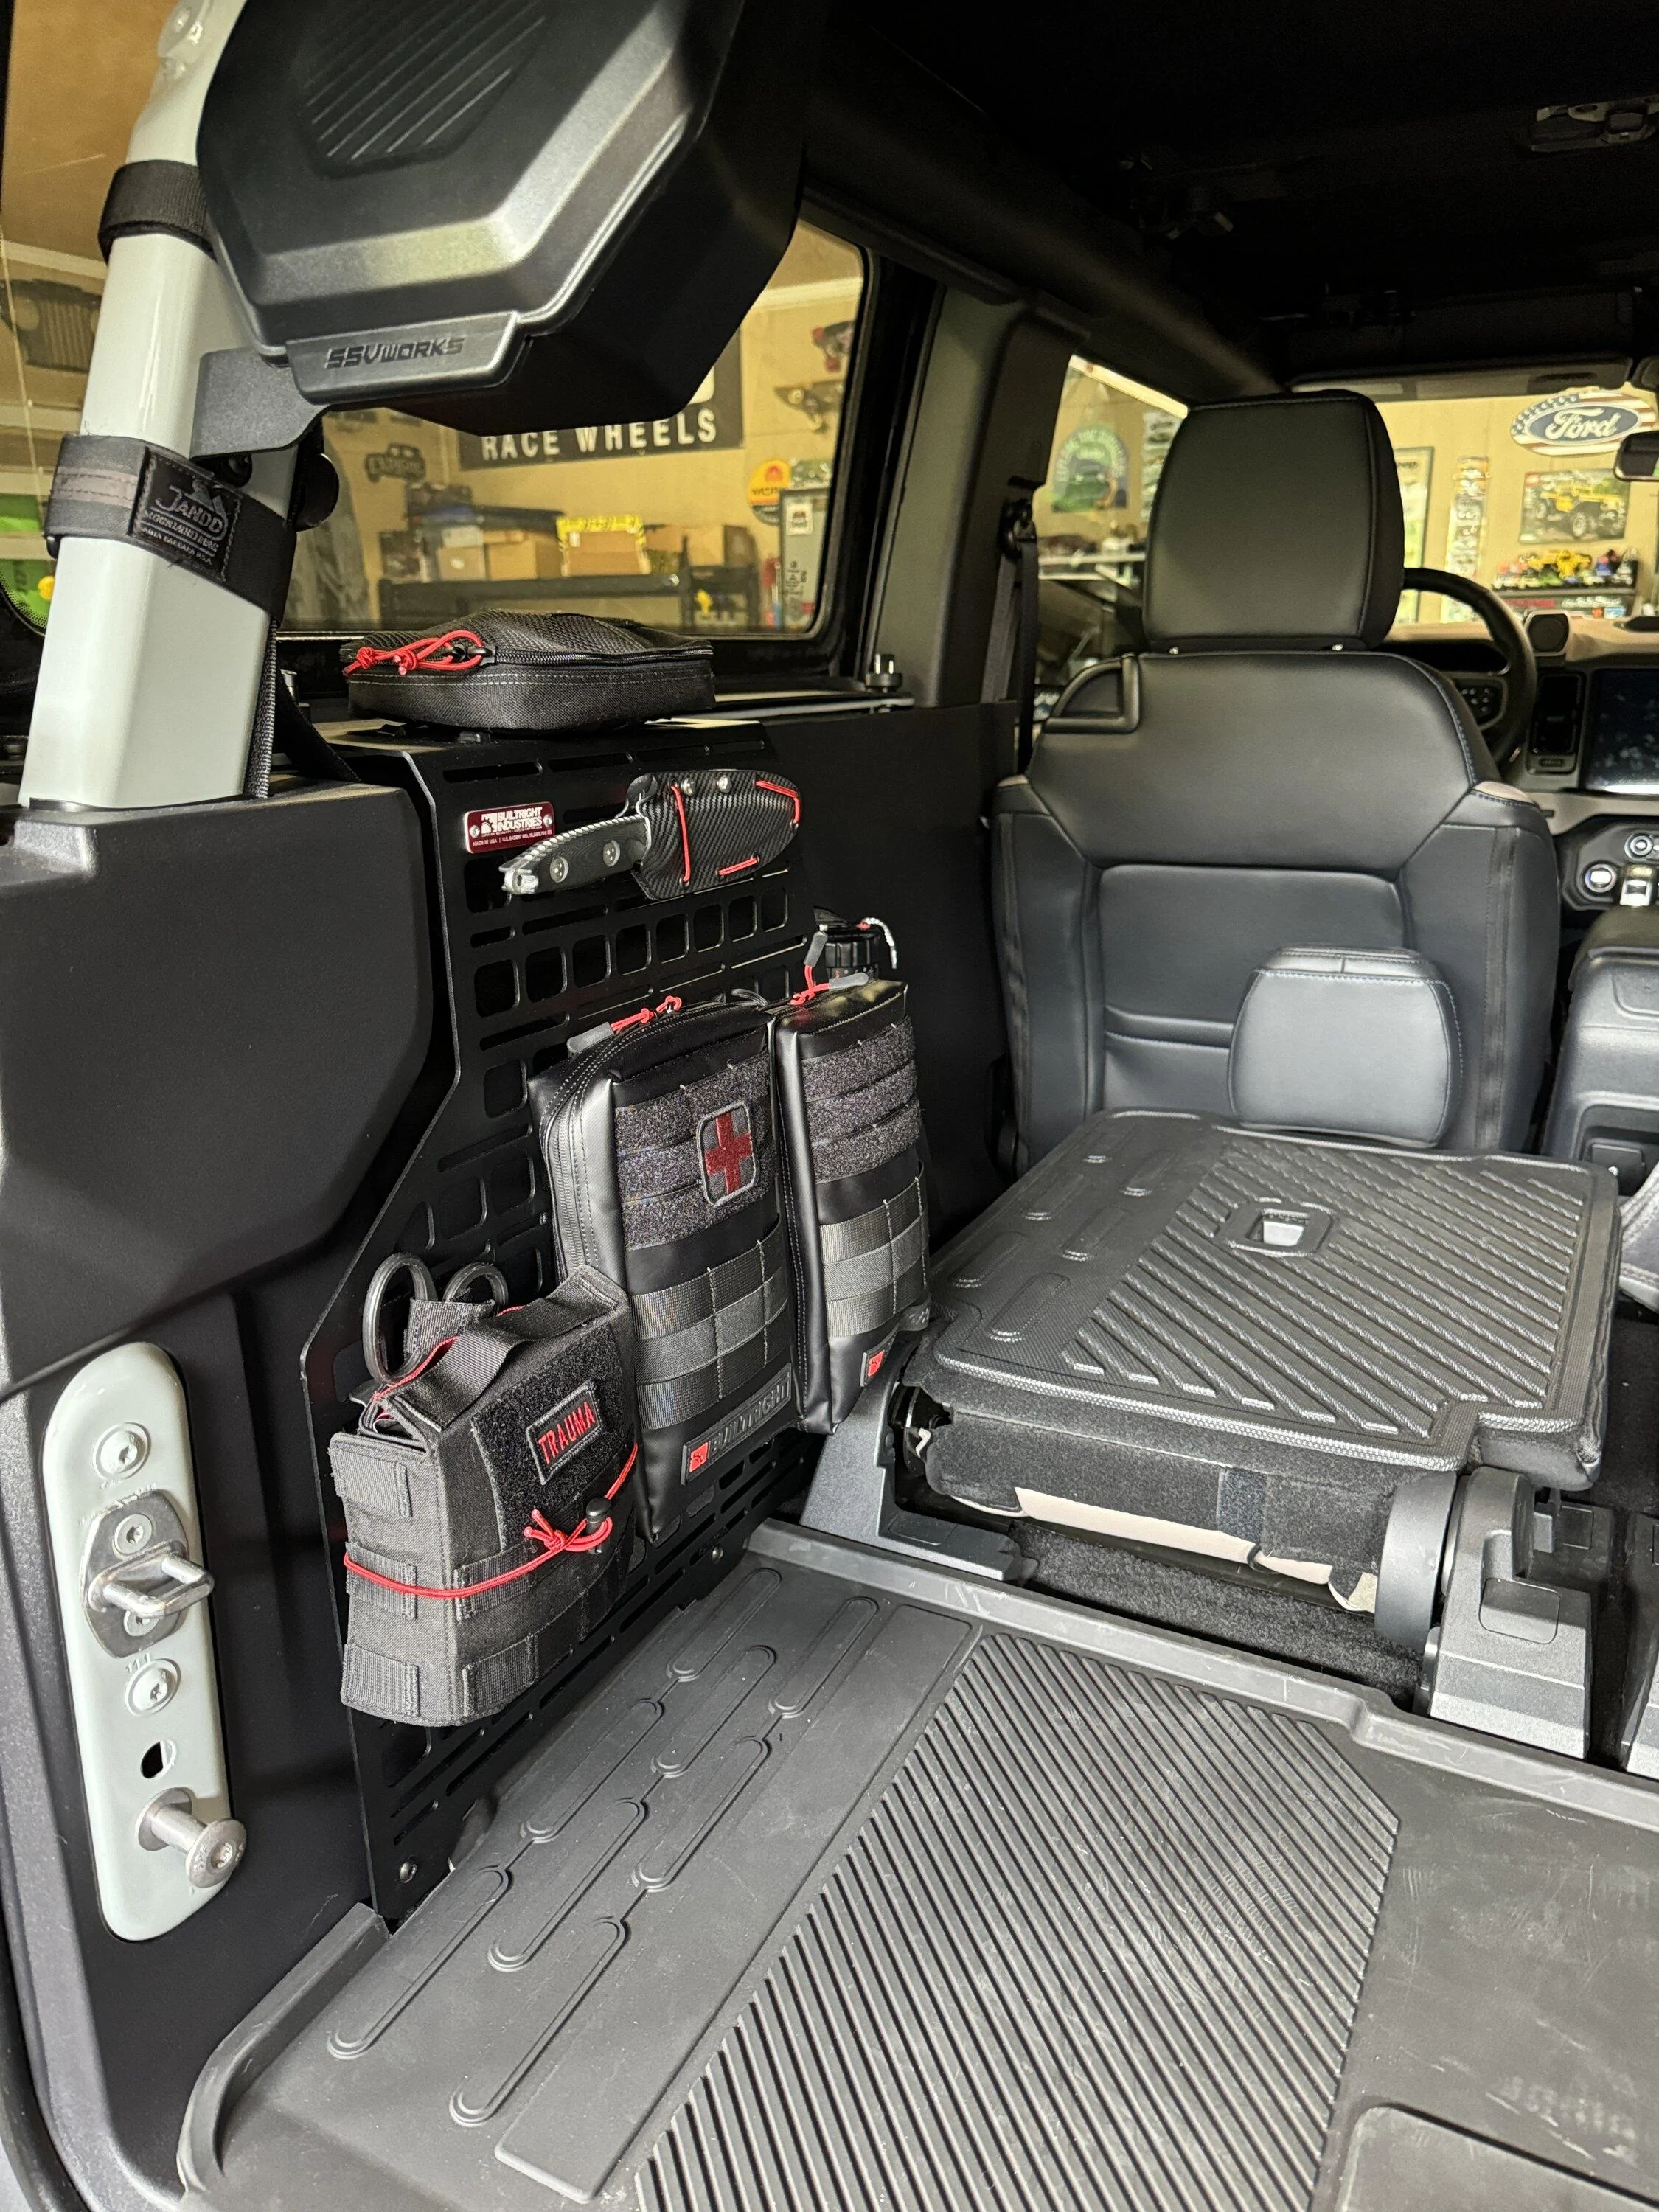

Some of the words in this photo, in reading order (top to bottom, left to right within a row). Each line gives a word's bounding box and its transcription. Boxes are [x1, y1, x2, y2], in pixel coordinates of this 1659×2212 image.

[324, 337, 465, 369] SSVWORKS
[481, 430, 560, 461] RACE
[575, 408, 717, 453] WHEELS
[1545, 408, 1621, 439] Ford
[155, 485, 223, 534] JANDD
[497, 807, 543, 821] BUILTRIGHT
[497, 816, 543, 832] INDUSTRIES
[538, 1401, 596, 1464] TRAUMA
